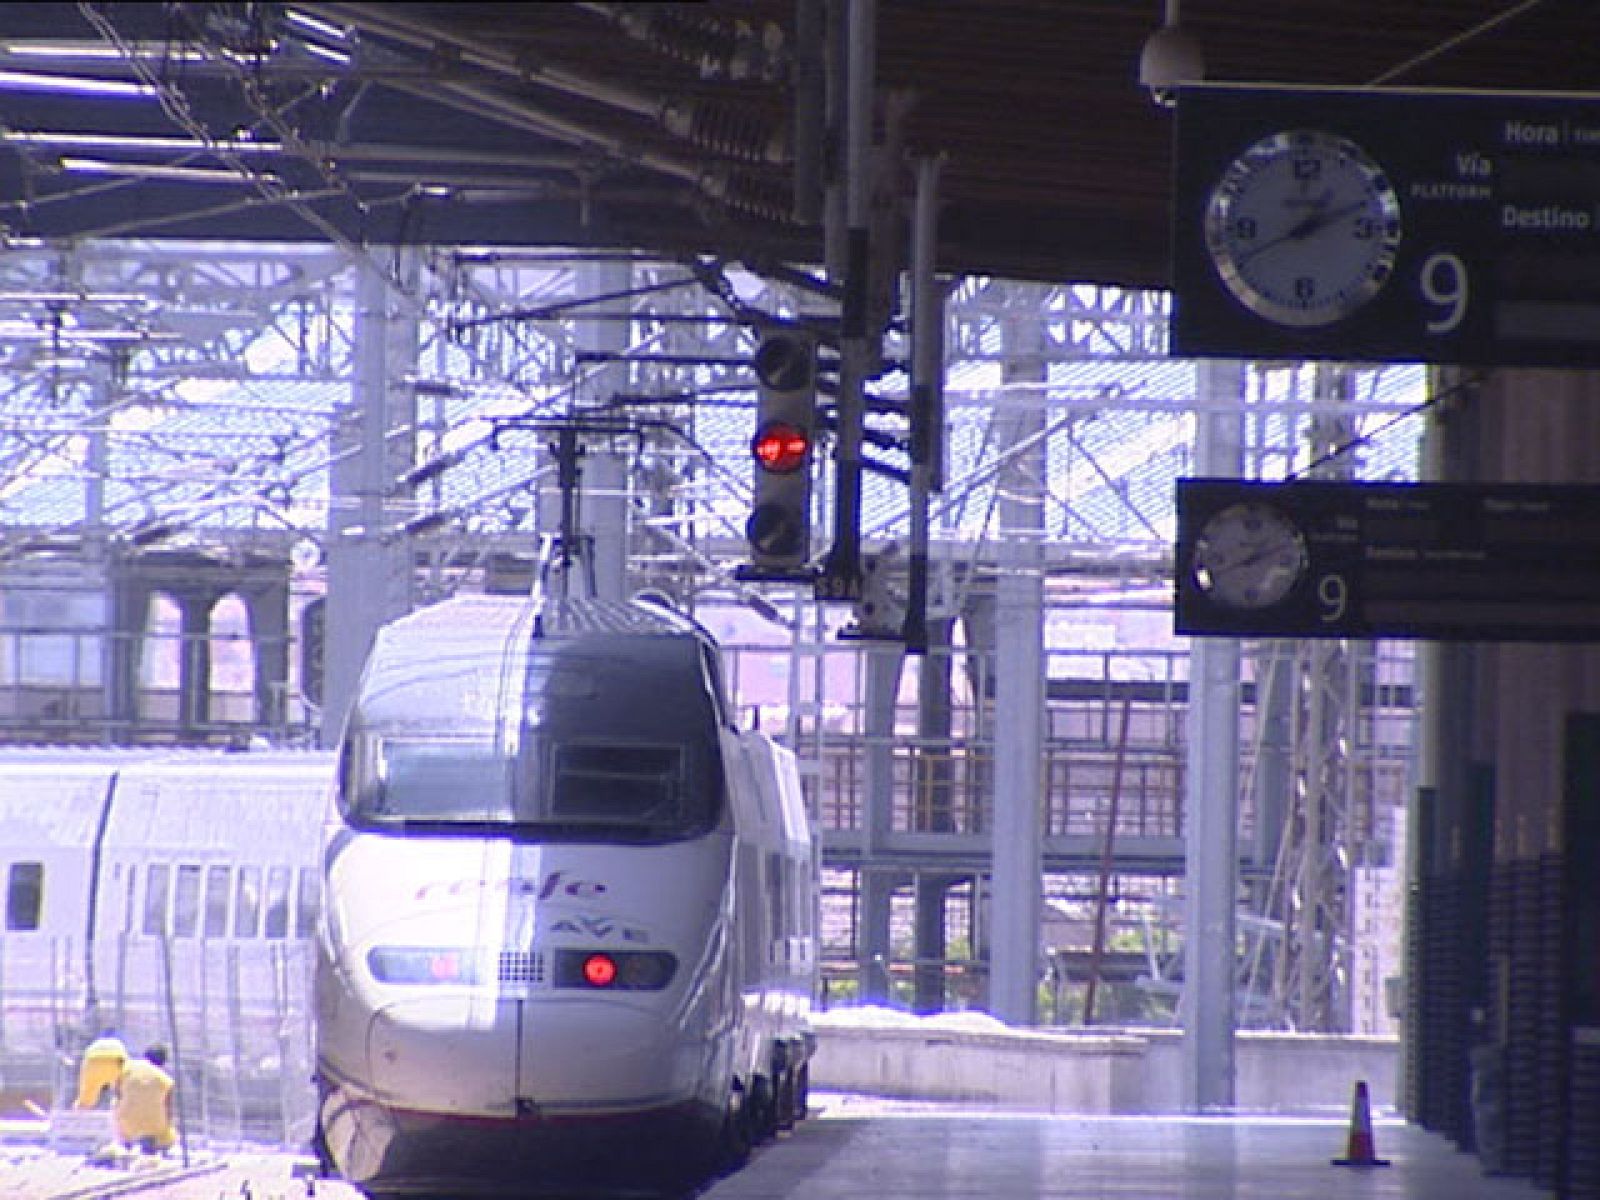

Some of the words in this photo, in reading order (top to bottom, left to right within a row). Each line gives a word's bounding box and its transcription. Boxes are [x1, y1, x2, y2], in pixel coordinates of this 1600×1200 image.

[1505, 120, 1559, 143] Hora
[1503, 204, 1591, 229] Destino
[1418, 253, 1470, 334] 9
[1317, 574, 1348, 622] 9
